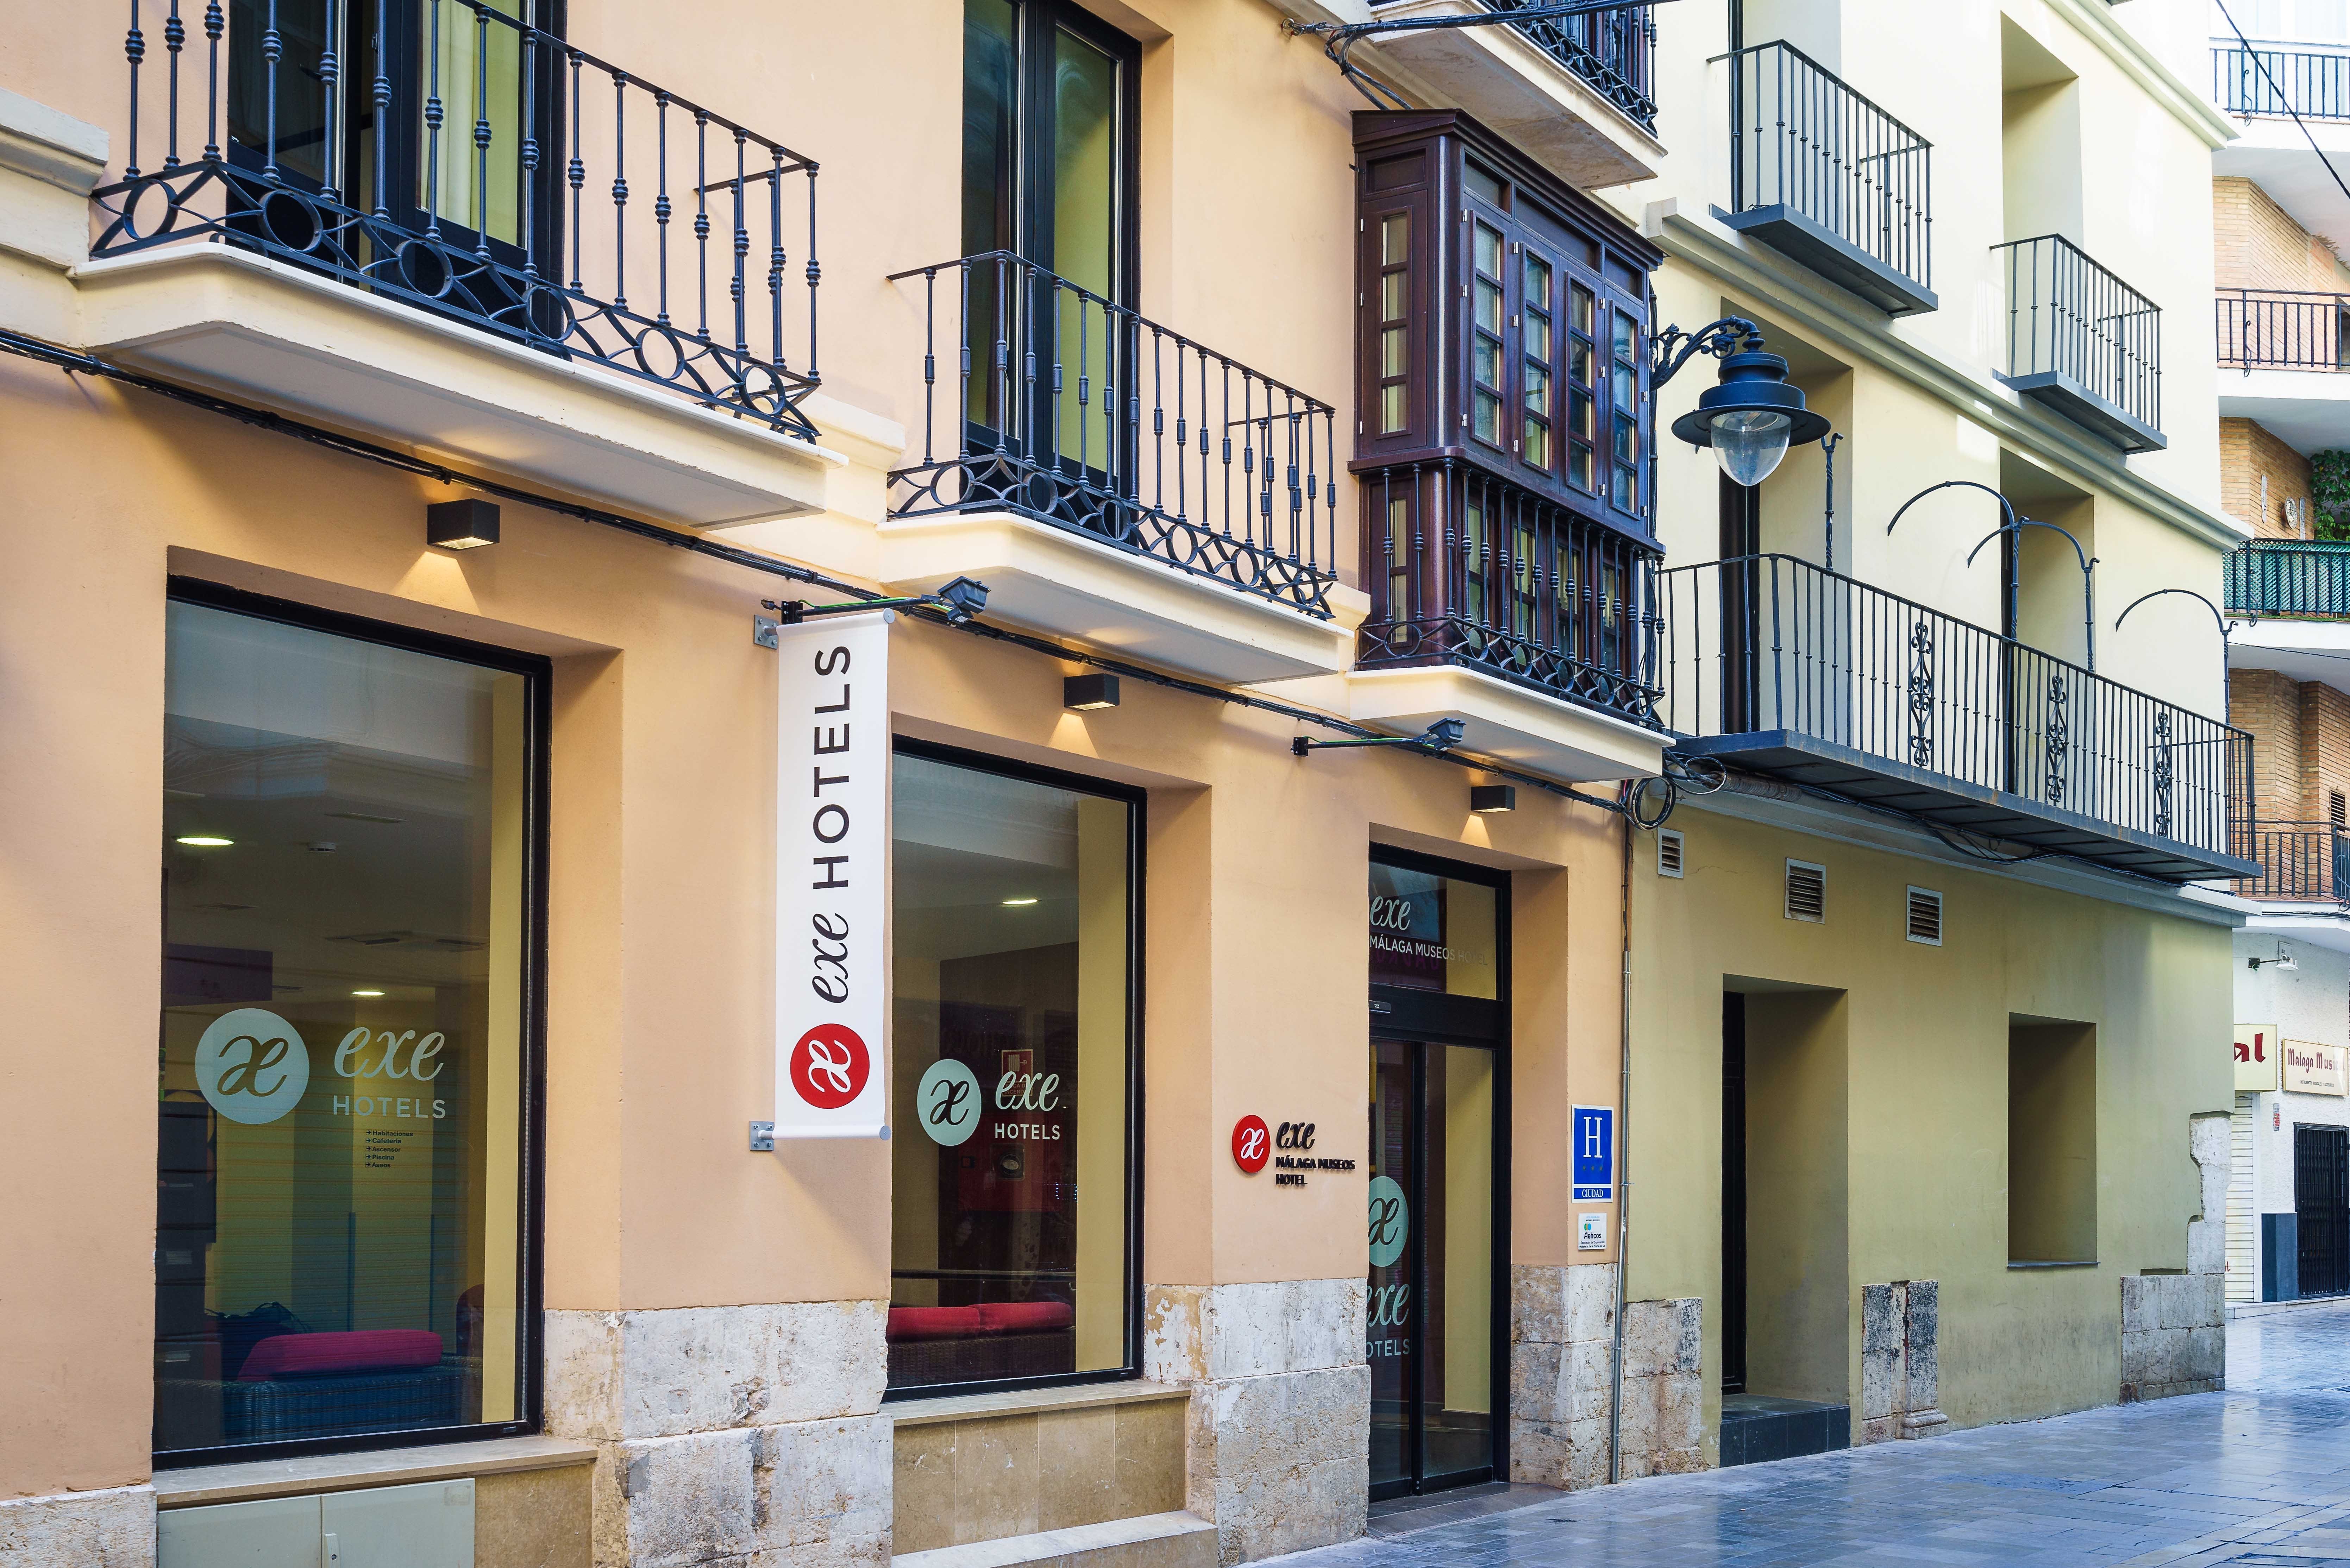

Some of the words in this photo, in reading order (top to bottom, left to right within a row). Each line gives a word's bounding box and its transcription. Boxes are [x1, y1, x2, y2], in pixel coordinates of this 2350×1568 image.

[813, 646, 851, 889] HOTELS
[1370, 896, 1411, 930] exe
[812, 913, 849, 1003] exe
[1370, 934, 1413, 954] MÁLAGA
[1416, 943, 1455, 961] MUSEOS
[334, 1026, 445, 1081] exe
[2288, 1048, 2313, 1073] Malaga
[995, 1071, 1059, 1111] exe
[333, 1095, 446, 1119] HOTELS
[995, 1123, 1060, 1140] HOTELS
[1276, 1121, 1315, 1149] exe
[1583, 1116, 1603, 1158] H
[1276, 1155, 1317, 1169] MÁLAGA
[1318, 1158, 1355, 1170] MUSEOS
[1276, 1174, 1308, 1185] HOTEL
[1582, 1189, 1603, 1198] CIUDAD
[1366, 1339, 1410, 1358] OTELS
